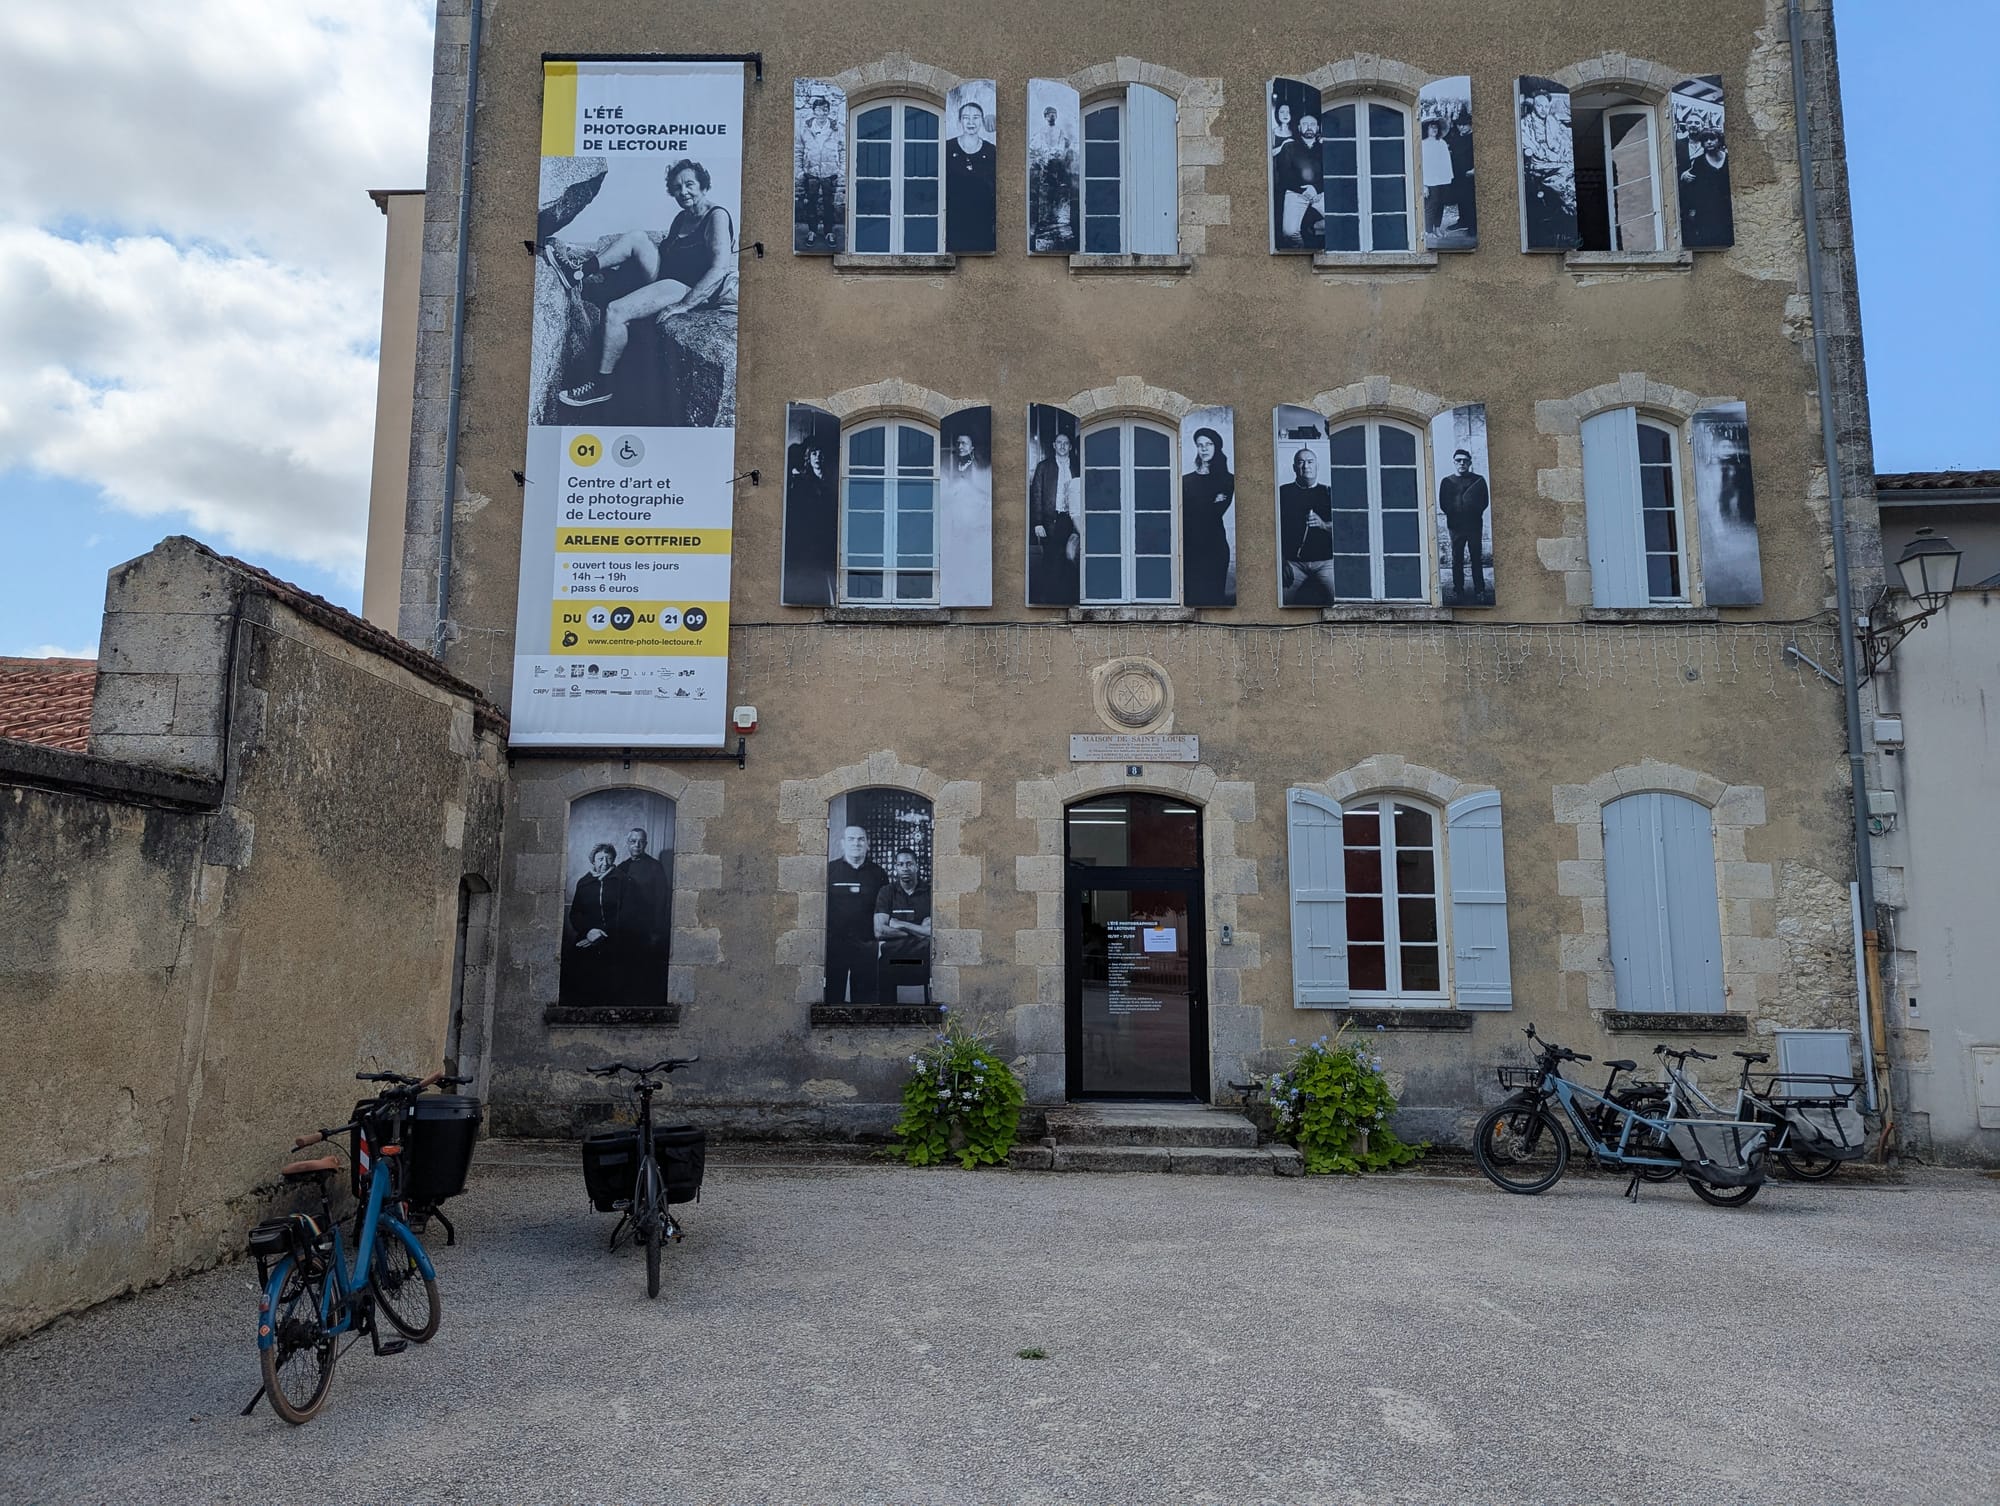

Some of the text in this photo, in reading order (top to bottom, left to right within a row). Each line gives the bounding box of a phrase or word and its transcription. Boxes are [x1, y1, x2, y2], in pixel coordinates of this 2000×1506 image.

[584, 105, 623, 119] L'ÉTÉ
[583, 124, 726, 136] PHOTOGRAPHIQUE
[583, 139, 688, 151] DE LECTOURE
[577, 445, 595, 457] 01
[567, 476, 615, 489] Centre
[656, 478, 671, 489] et
[566, 492, 685, 507] de photographie
[566, 508, 652, 521] de Lectoure
[564, 535, 702, 547] ARLENE GOTTFRIED
[572, 560, 680, 571] ouvert tous les jours
[572, 572, 627, 581] 14h 19h
[570, 584, 639, 594] pass 6 euros
[563, 614, 704, 624] DU 12 07 AU 21 09
[587, 637, 703, 646] www.centre-photo-lectoure.fr
[1082, 735, 1113, 743] MAISON
[1117, 735, 1128, 743] DE
[1131, 766, 1137, 775] 8
